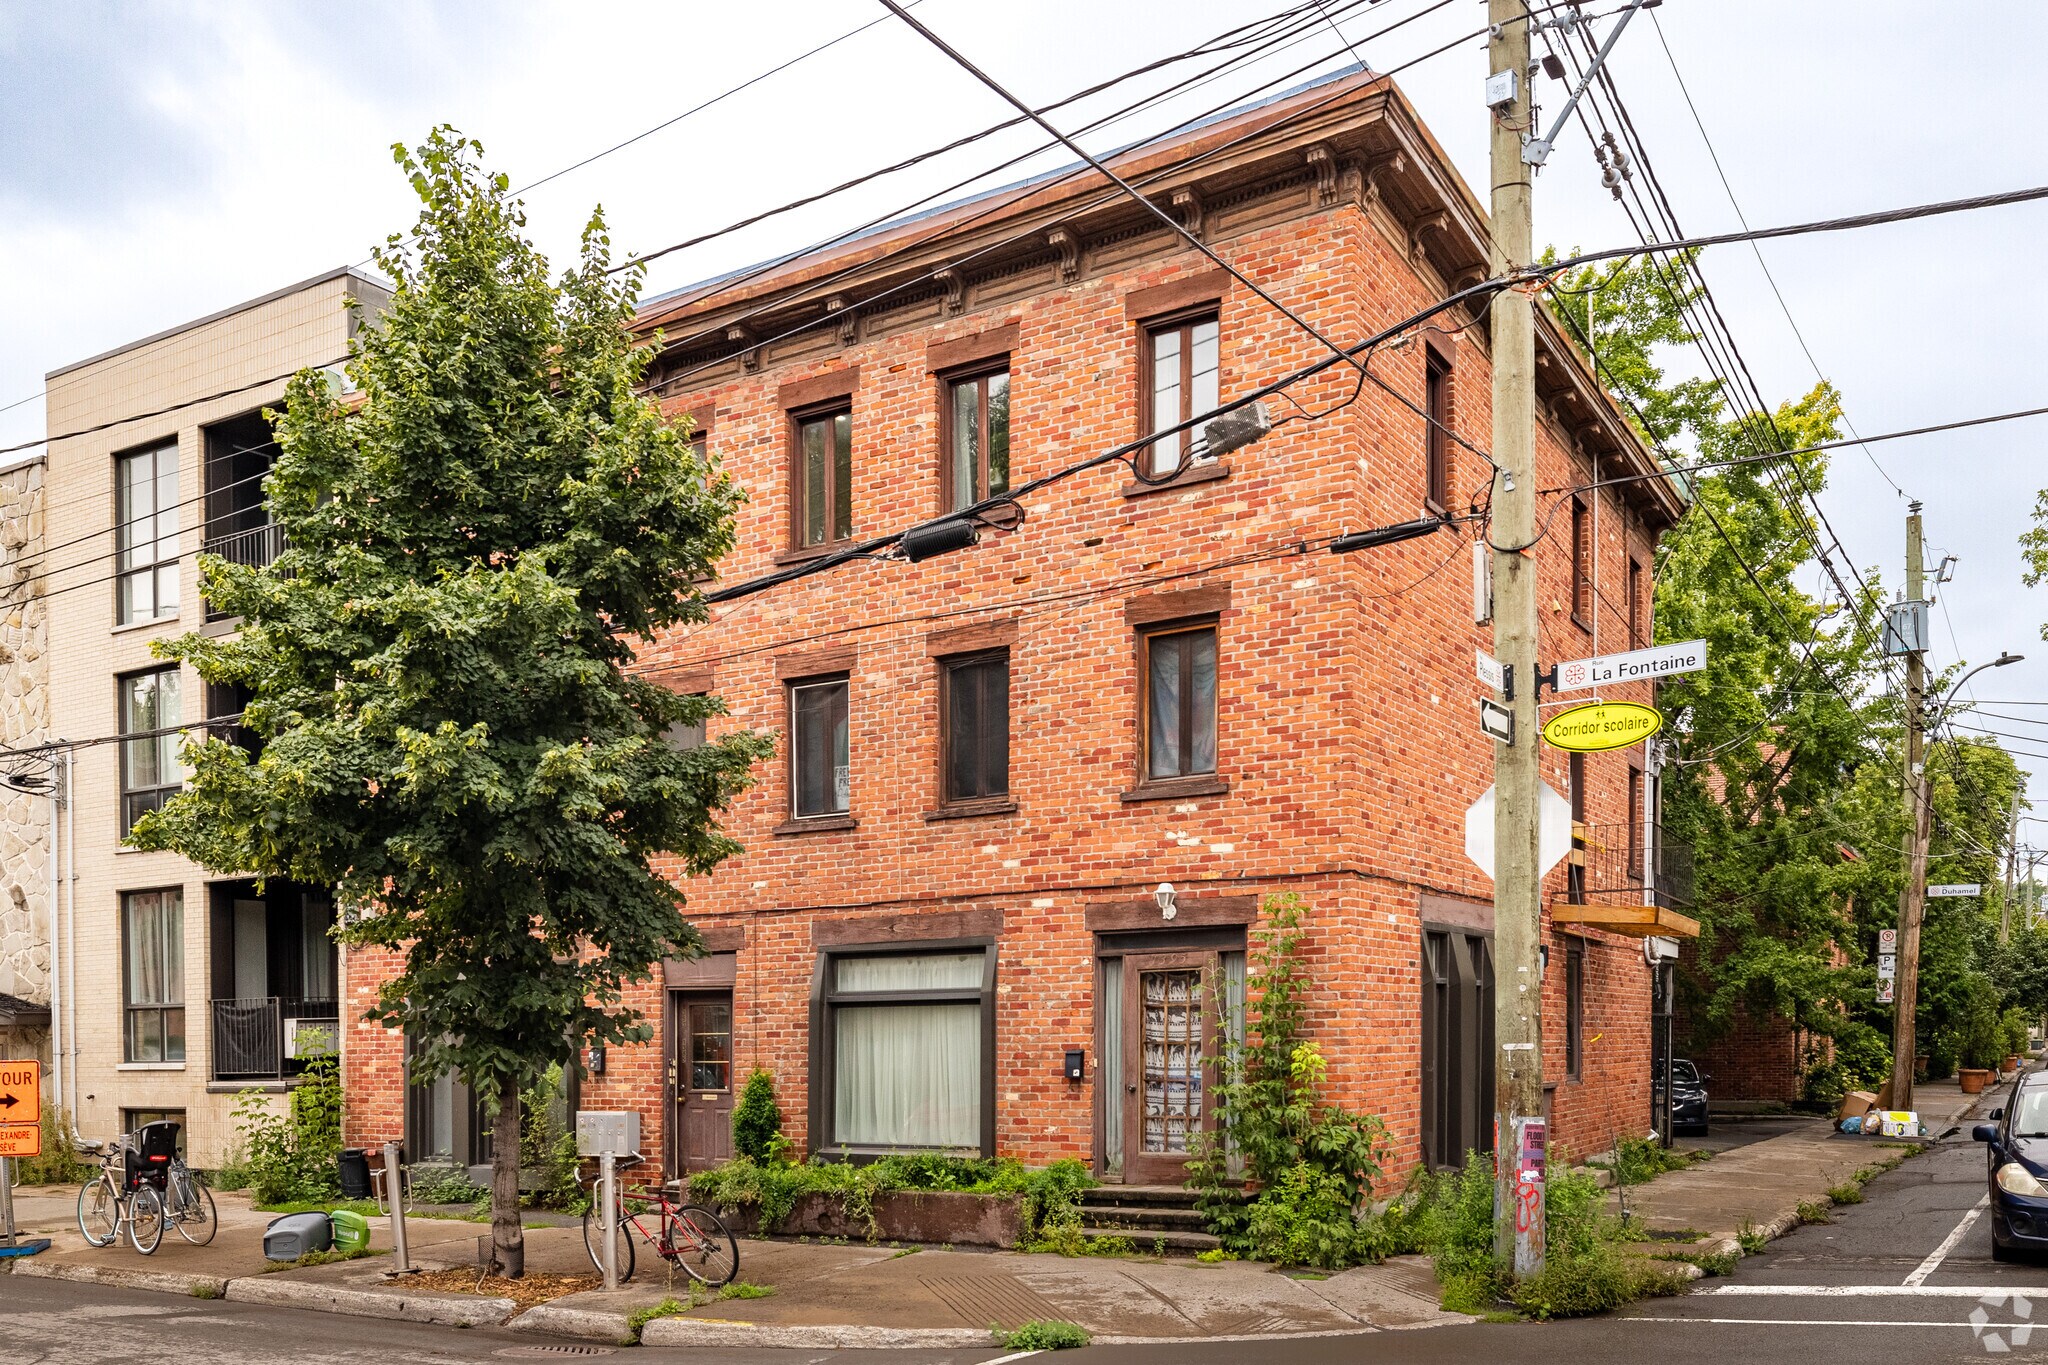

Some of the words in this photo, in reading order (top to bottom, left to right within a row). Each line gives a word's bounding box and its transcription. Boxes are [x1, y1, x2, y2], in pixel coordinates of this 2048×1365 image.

[1592, 668, 1612, 681] La
[1619, 655, 1696, 678] Fontaine
[1553, 721, 1601, 738] Corridor
[1603, 716, 1649, 733] scolaire
[1941, 887, 1976, 895] Duhamel
[0, 1071, 32, 1086] OUR
